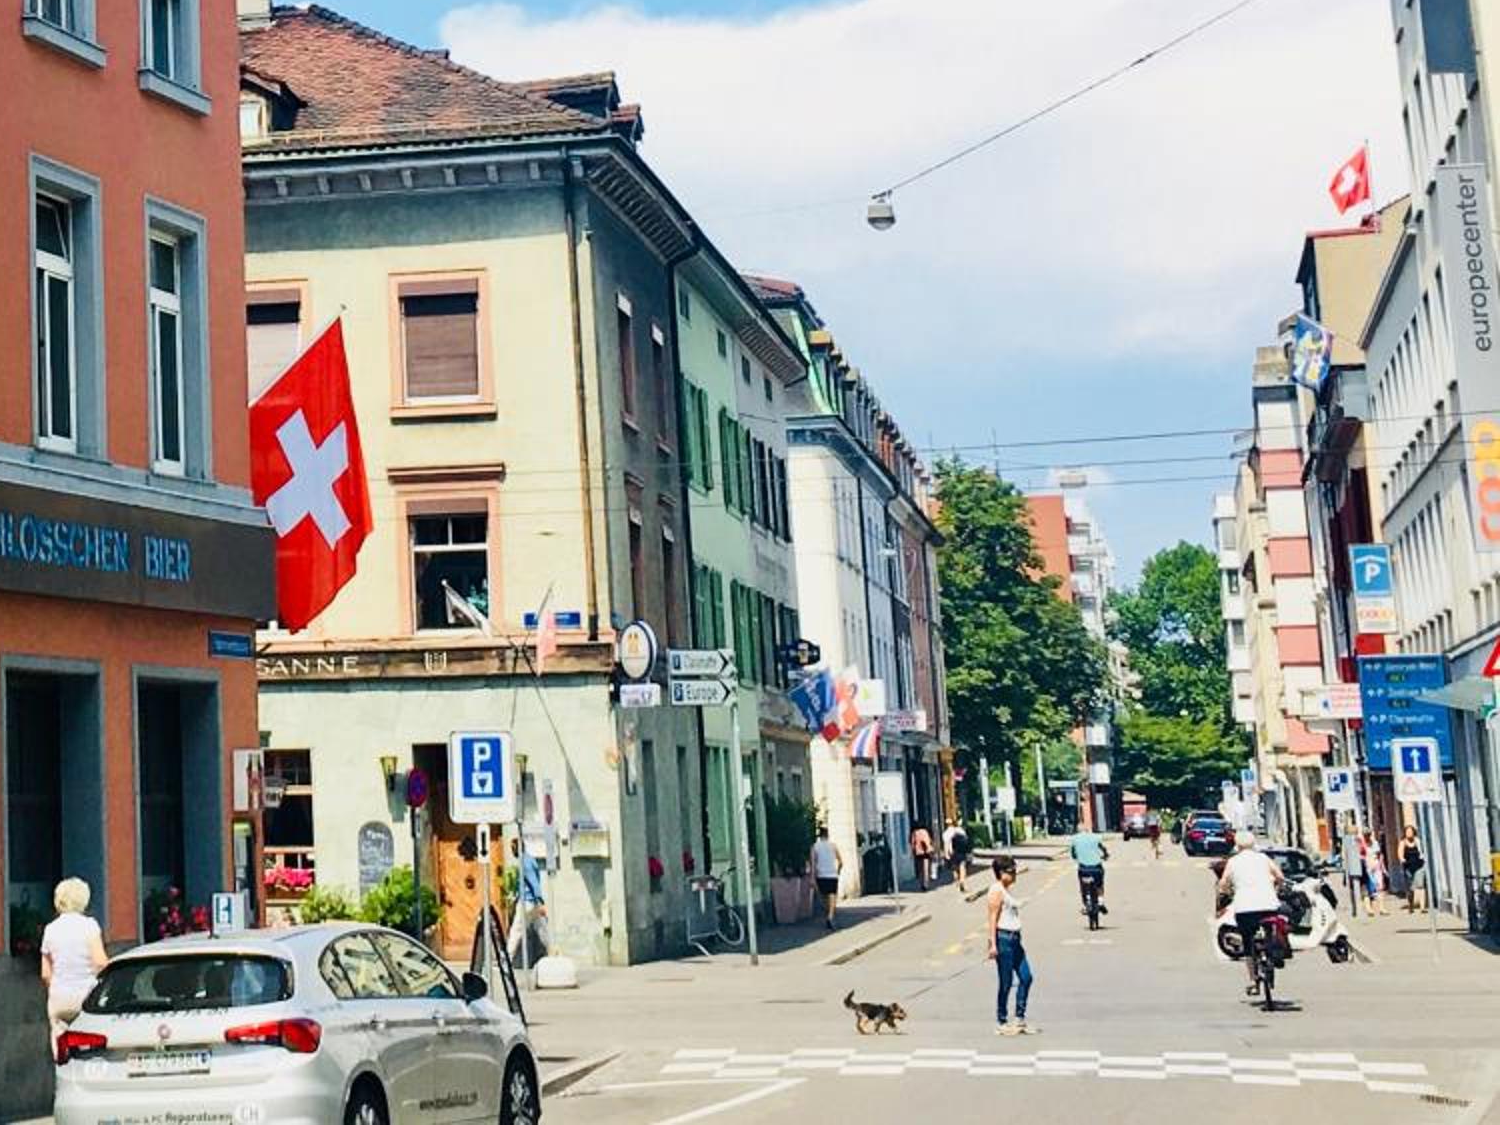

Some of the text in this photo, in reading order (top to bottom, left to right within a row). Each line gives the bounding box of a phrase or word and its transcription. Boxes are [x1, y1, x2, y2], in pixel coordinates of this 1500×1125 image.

[1456, 173, 1492, 352] europecenter
[144, 534, 192, 582] BIER
[473, 741, 491, 771] P
